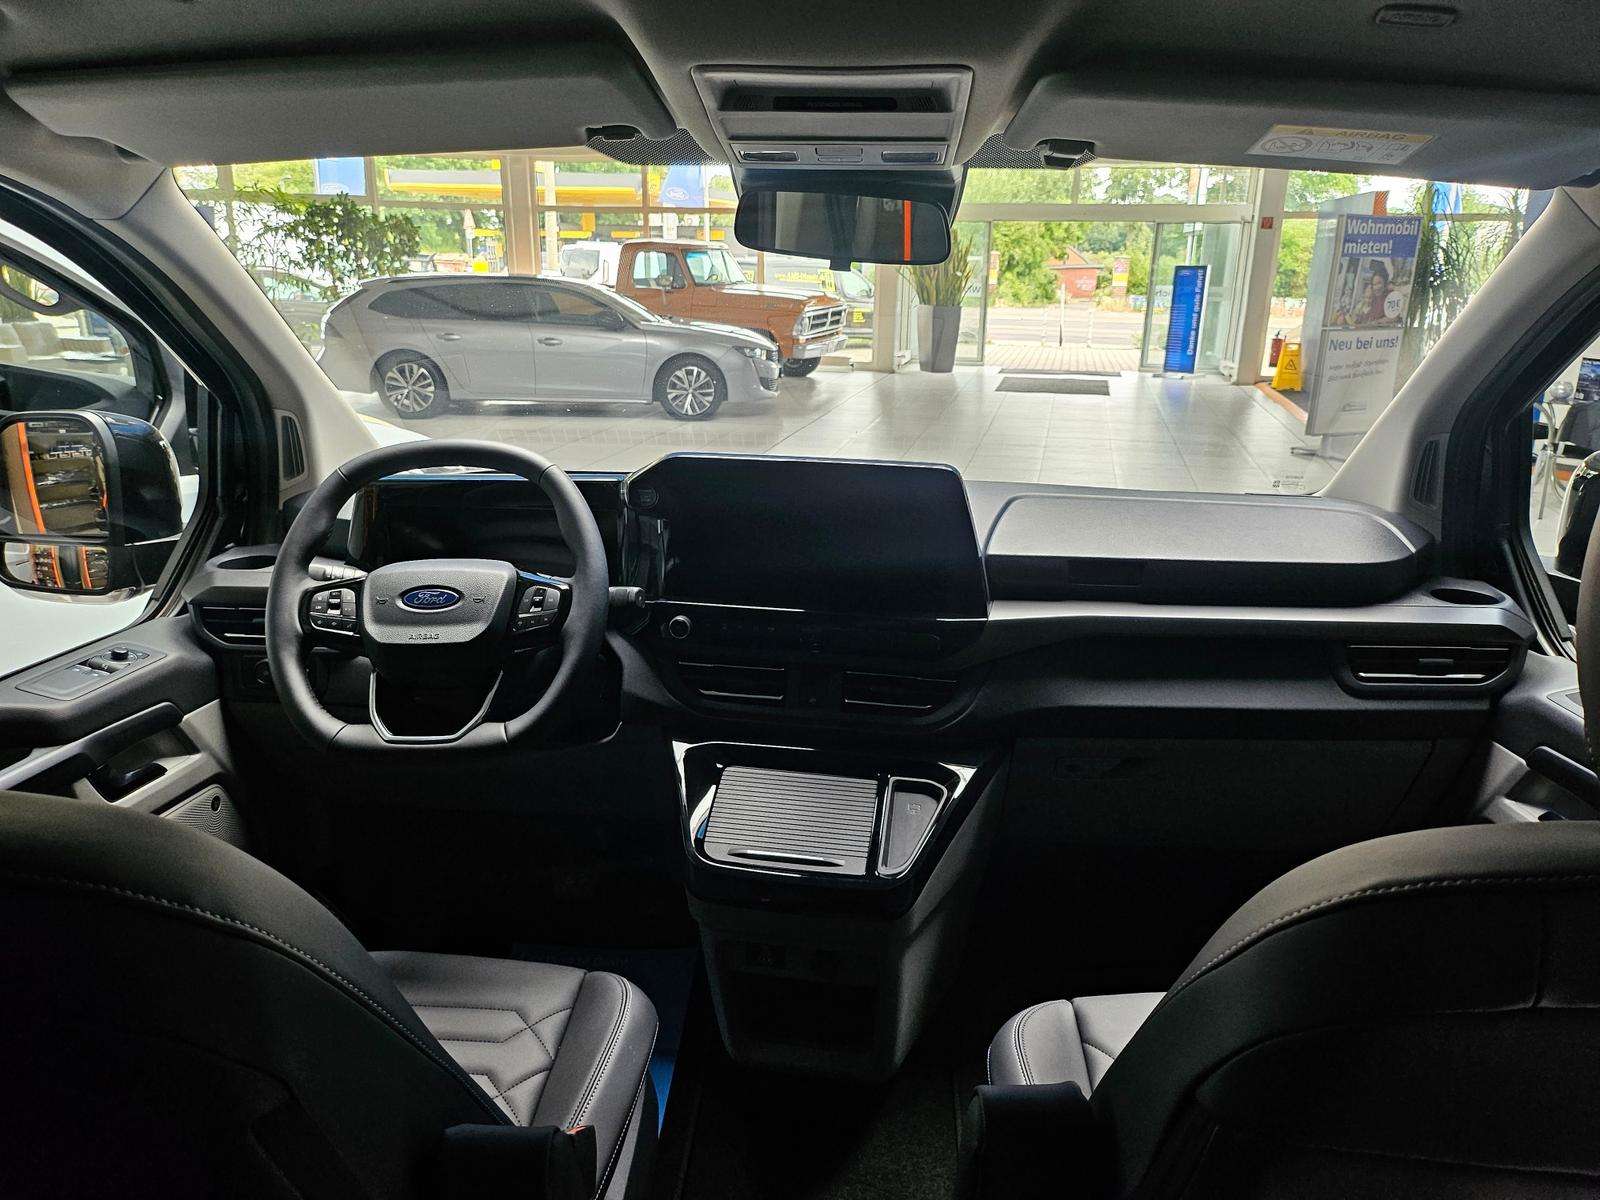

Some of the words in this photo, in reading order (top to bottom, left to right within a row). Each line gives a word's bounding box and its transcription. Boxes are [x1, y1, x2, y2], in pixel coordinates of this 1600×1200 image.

[1335, 130, 1408, 141] AIRBAG
[1346, 219, 1419, 235] Wohnmobil
[1344, 239, 1393, 254] mieten!
[1328, 339, 1352, 351] Neu
[1355, 337, 1373, 350] bei
[1375, 336, 1399, 349] uns!
[414, 592, 448, 604] Ford
